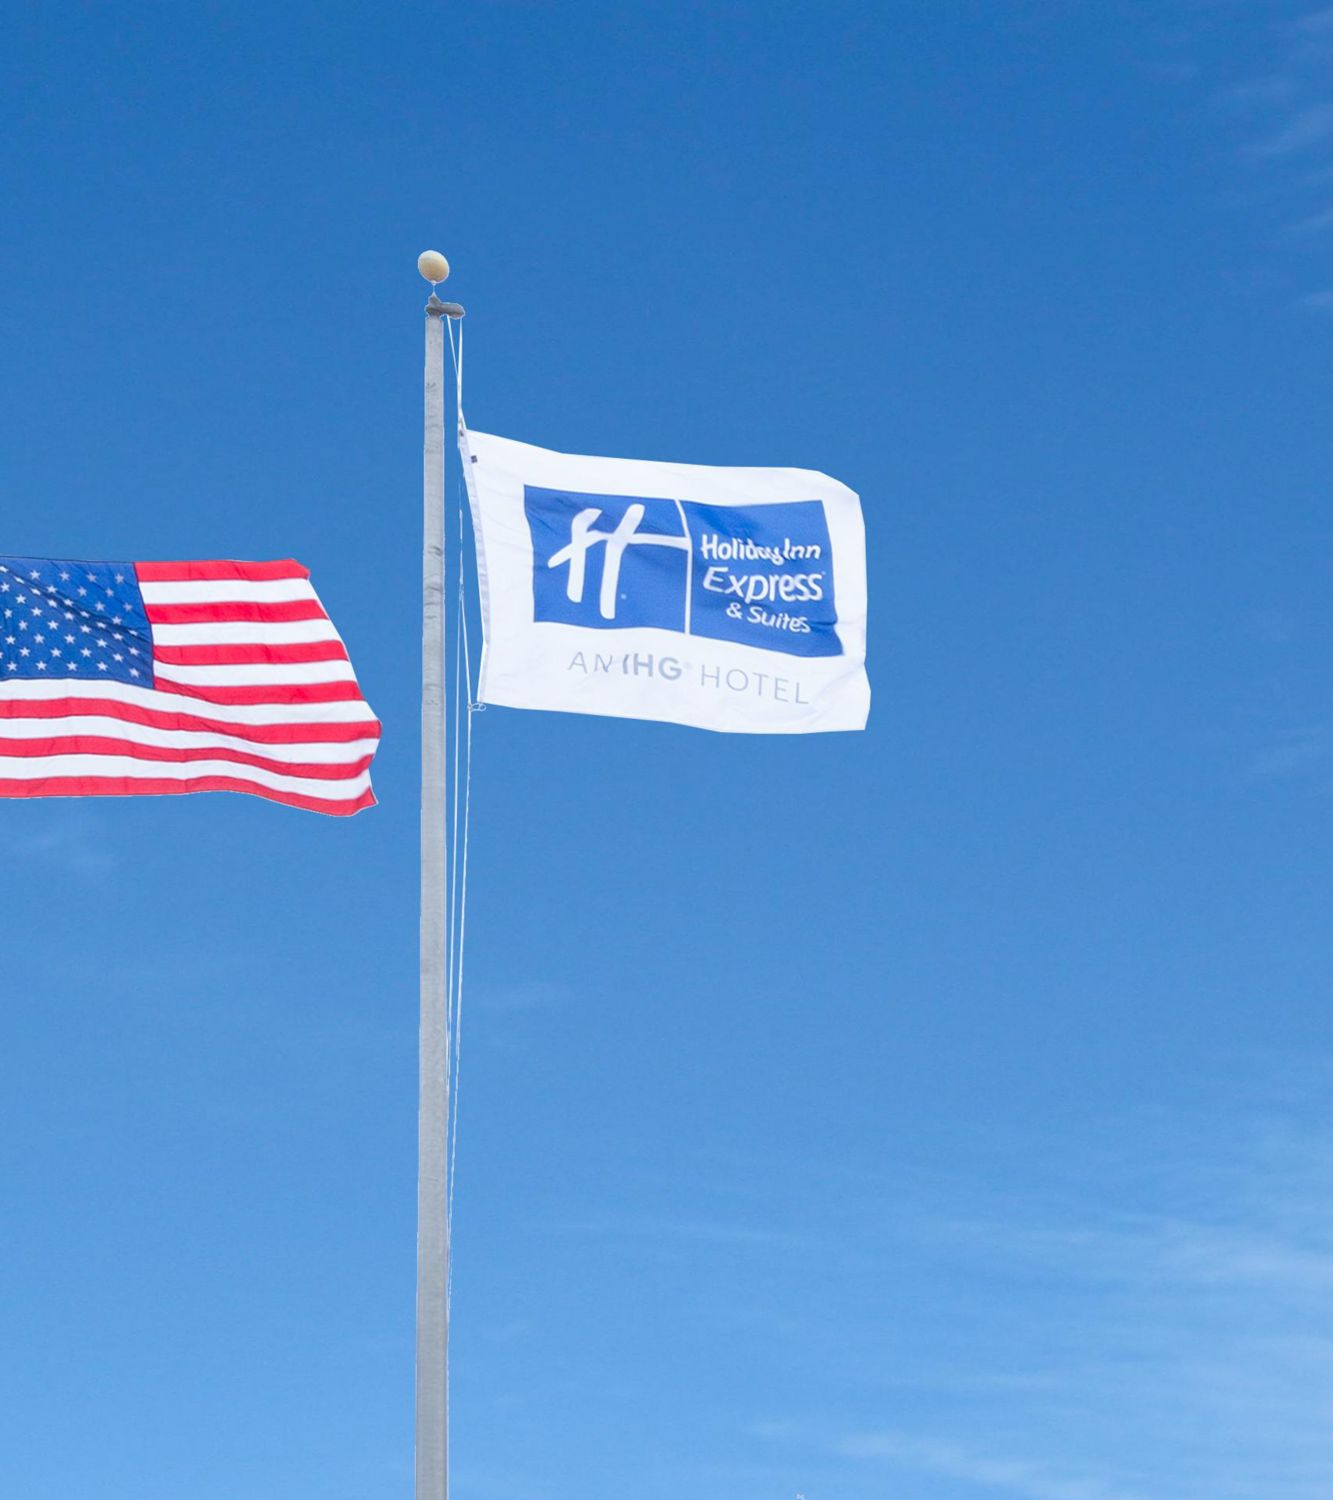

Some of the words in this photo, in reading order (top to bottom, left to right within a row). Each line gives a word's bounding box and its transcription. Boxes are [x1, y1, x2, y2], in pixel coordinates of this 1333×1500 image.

[701, 534, 783, 566] Holiday
[783, 538, 822, 561] Inn
[703, 566, 823, 604] Express
[725, 602, 742, 620] &
[747, 606, 812, 634] Suites
[621, 652, 684, 680] IHG
[699, 664, 809, 705] HOTEL
